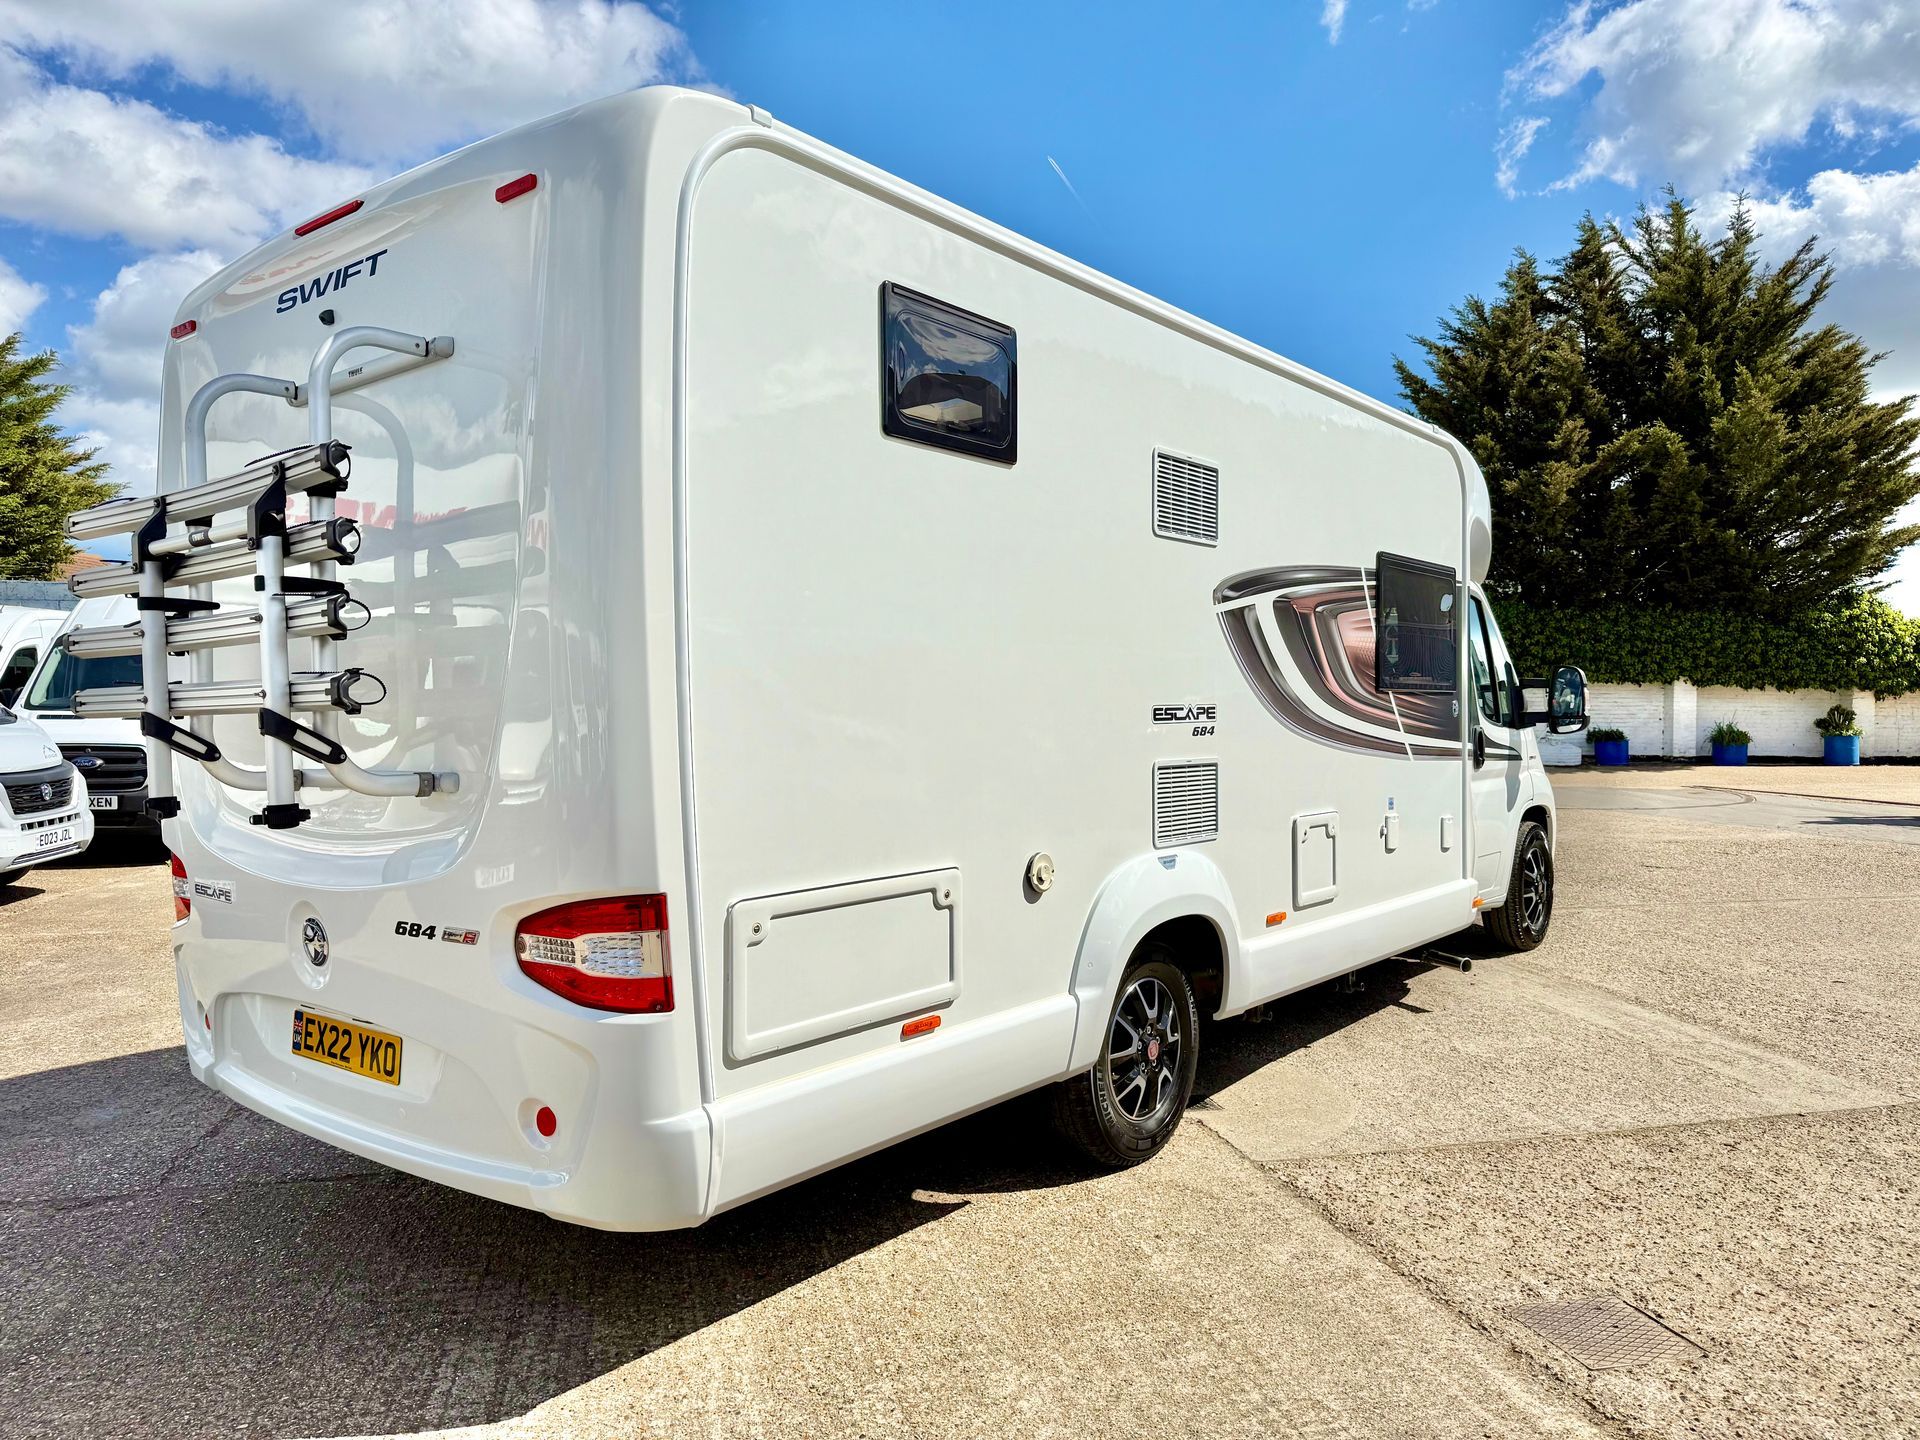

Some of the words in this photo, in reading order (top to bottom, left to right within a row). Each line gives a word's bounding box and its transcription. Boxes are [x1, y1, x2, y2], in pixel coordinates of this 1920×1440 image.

[277, 249, 388, 313] SWIFT
[1153, 707, 1216, 721] ESCAPE
[1192, 726, 1214, 736] 684
[89, 797, 112, 808] XEN
[40, 831, 58, 847] EO23
[60, 828, 72, 841] JZL
[195, 884, 232, 901] ESCAPE
[395, 921, 436, 940] 684
[303, 1017, 352, 1064] EX22
[358, 1033, 396, 1077] YKO
